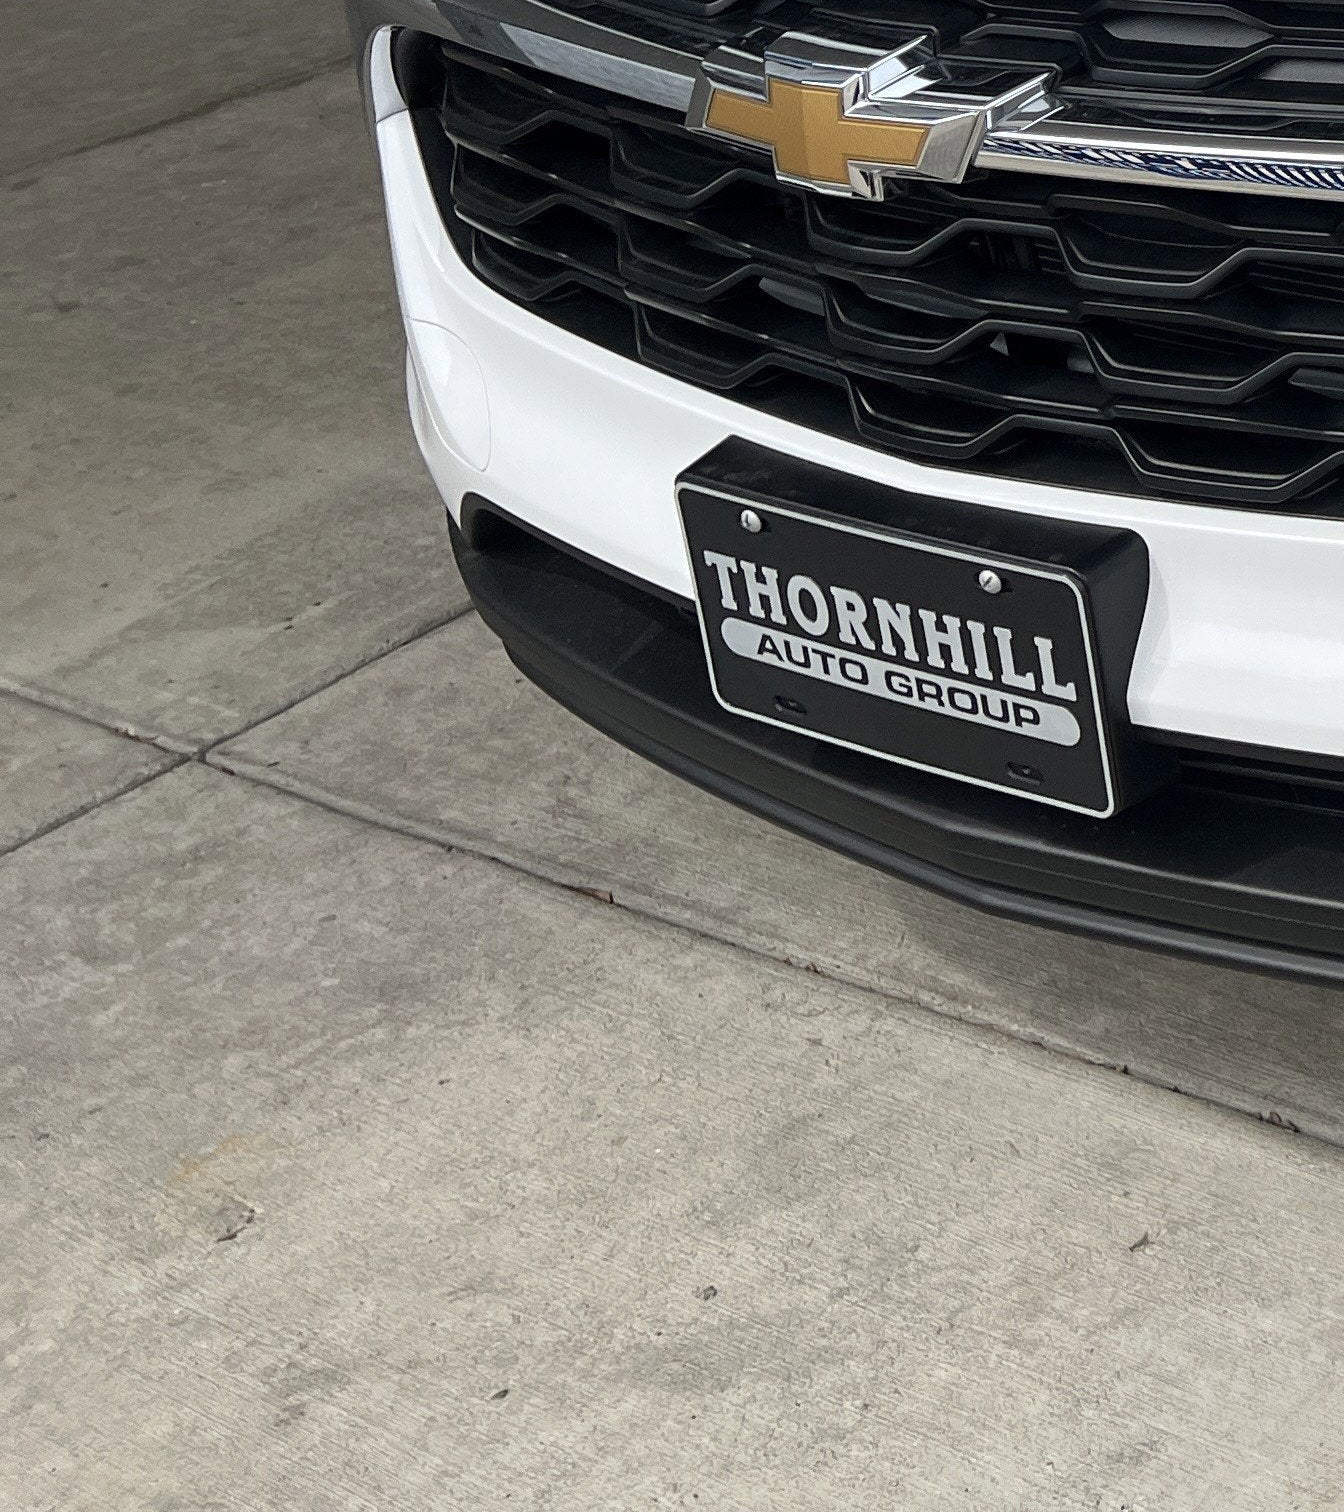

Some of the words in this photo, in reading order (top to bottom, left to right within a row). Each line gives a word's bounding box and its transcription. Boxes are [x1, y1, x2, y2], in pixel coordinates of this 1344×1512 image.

[703, 550, 1078, 702] THORNHILL
[756, 633, 869, 686] AUTO
[885, 670, 1041, 729] GROUP
